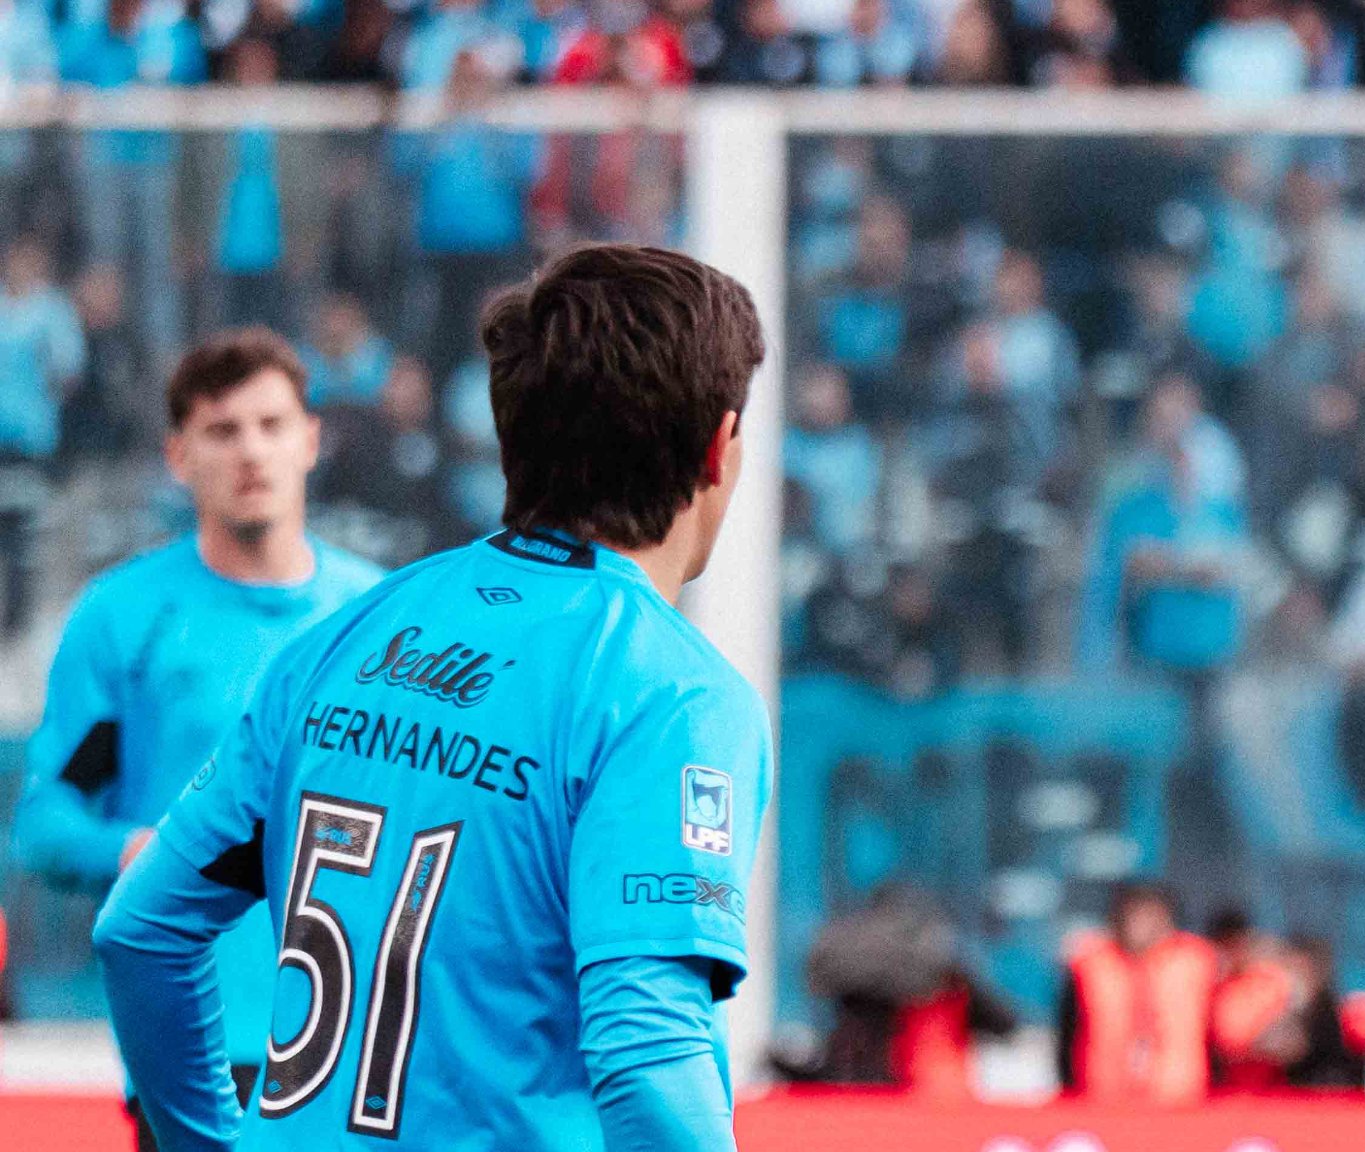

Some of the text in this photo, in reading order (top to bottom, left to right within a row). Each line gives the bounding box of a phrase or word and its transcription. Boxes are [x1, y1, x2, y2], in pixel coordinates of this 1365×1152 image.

[355, 626, 516, 709] Sedilé
[302, 701, 542, 801] HERNANDES
[685, 823, 730, 854] LPF
[259, 790, 464, 1141] 51
